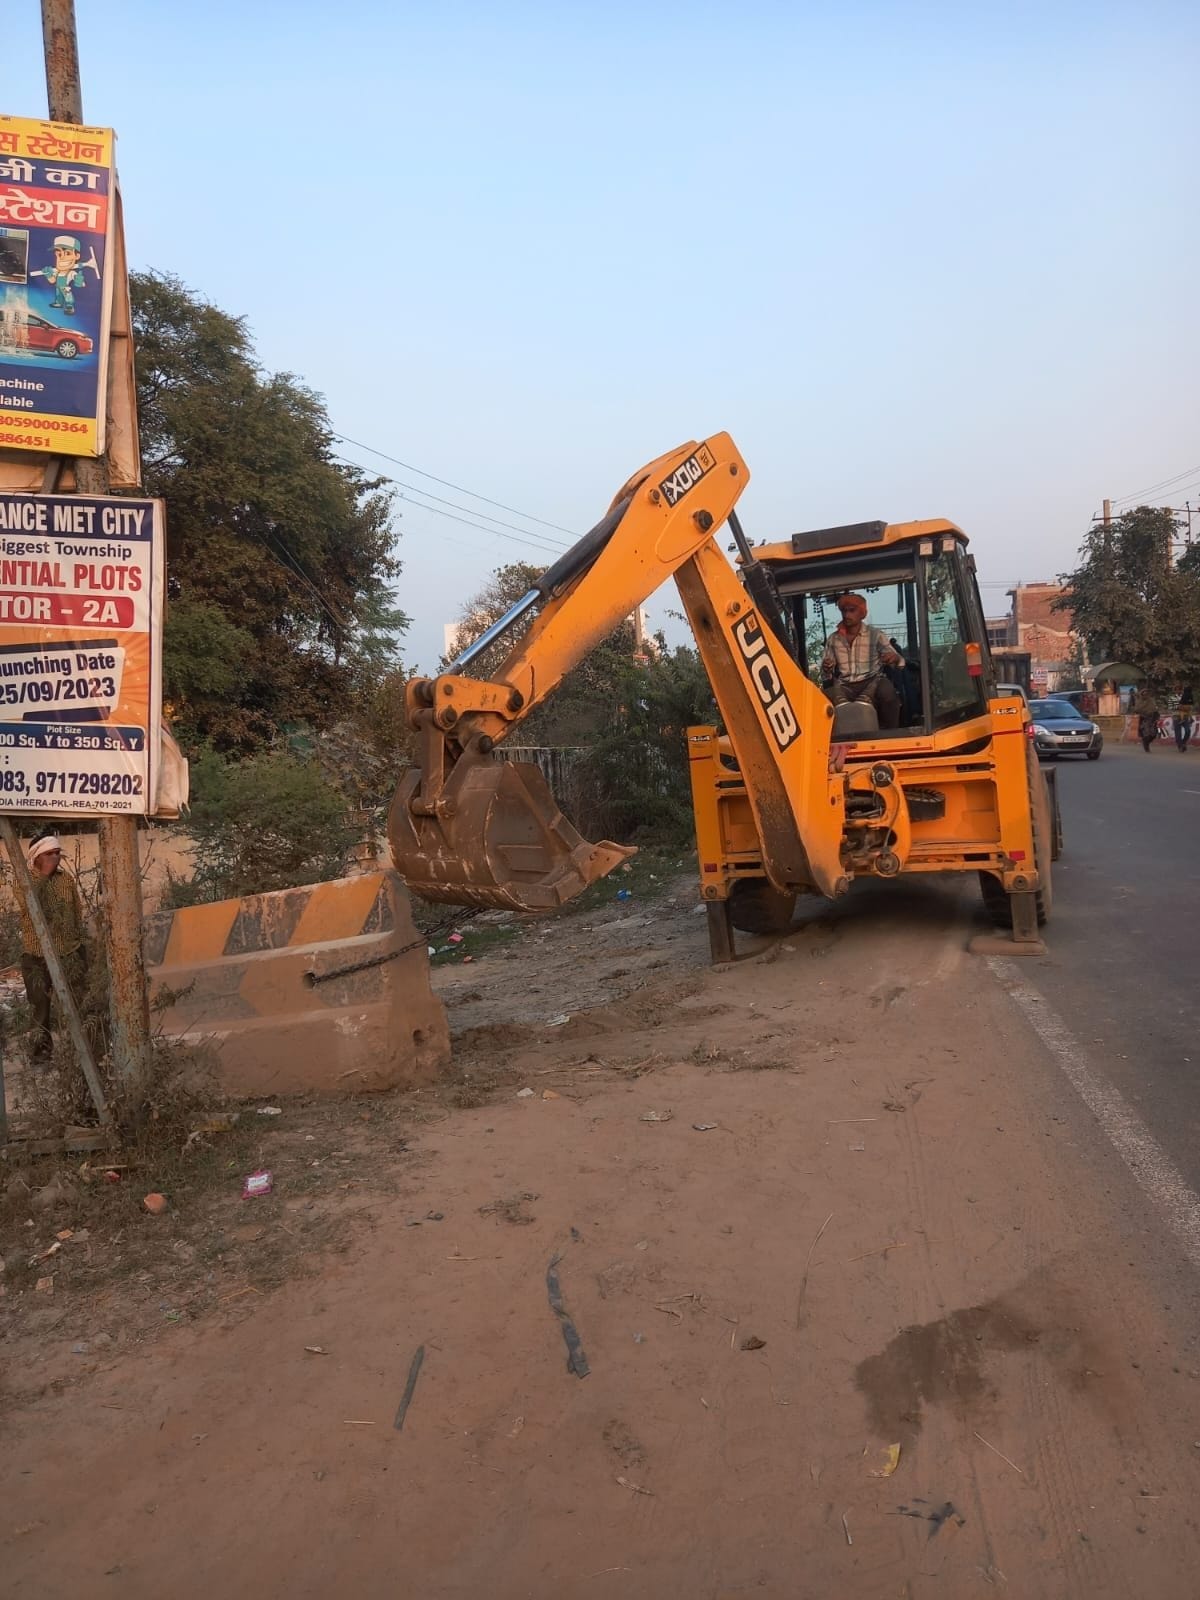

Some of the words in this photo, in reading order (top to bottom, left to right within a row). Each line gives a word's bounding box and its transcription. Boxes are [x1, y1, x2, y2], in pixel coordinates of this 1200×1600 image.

[27, 131, 104, 163] स्टेशन
[44, 167, 100, 190] का
[53, 505, 96, 534] MET
[101, 507, 145, 536] CITY
[0, 538, 50, 556] iggest
[55, 541, 132, 561] Township
[0, 560, 66, 588] NTIAL
[74, 563, 142, 592] PLOTS
[0, 595, 51, 620] TOR
[82, 600, 120, 624] 2A
[0, 655, 71, 677] unching
[76, 652, 116, 671] Date
[0, 676, 116, 705] 25/09/2023
[736, 622, 797, 747] JCB
[19, 734, 40, 748] Sq.
[44, 735, 53, 747] Y
[57, 737, 70, 747] to
[74, 736, 100, 749] 350
[129, 738, 138, 750] Y
[47, 725, 62, 734] Plot
[64, 726, 82, 734] Size
[36, 771, 143, 796] 9717298202
[16, 798, 132, 809] HRERA-PKL-REA-701-2021
